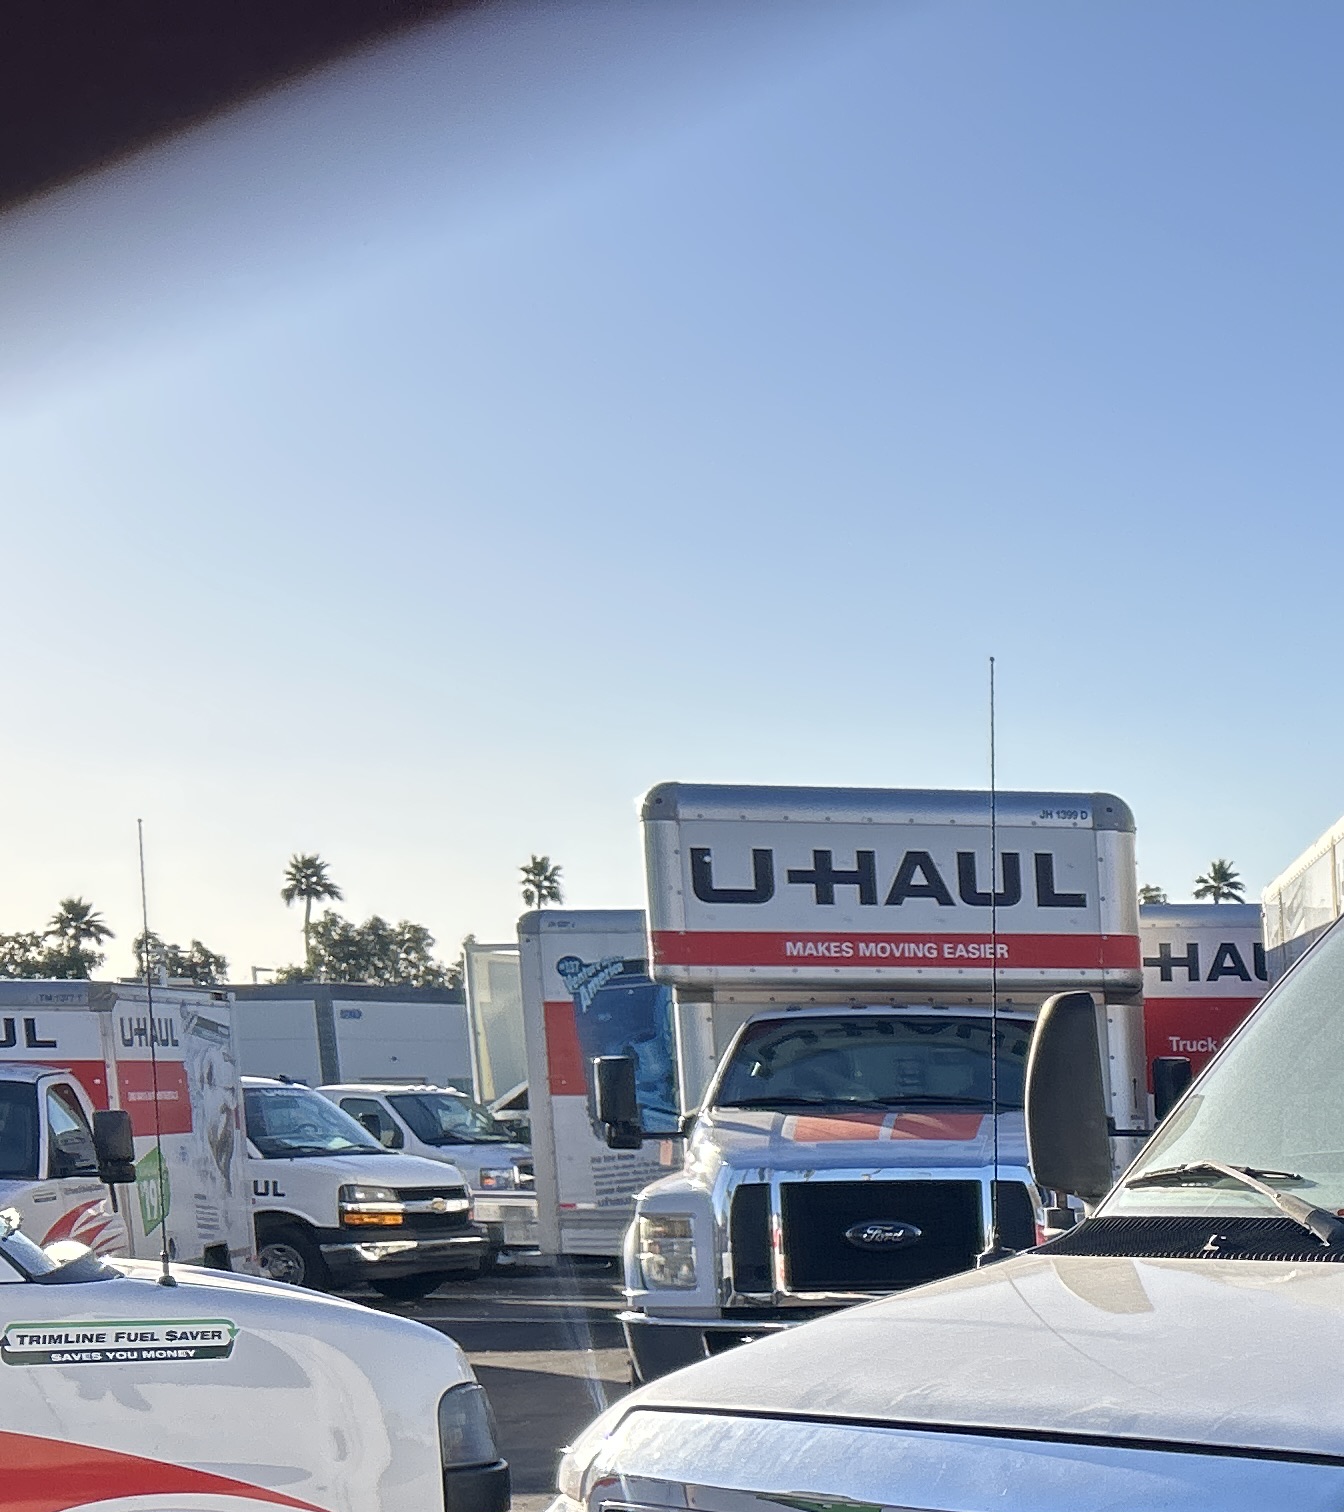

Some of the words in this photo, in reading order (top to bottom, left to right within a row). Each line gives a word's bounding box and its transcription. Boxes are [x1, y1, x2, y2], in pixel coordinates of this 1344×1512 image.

[1080, 810, 1088, 820] D
[690, 848, 1087, 908] U-HAUL
[786, 941, 854, 957] MAKES
[858, 942, 938, 958] MOVING
[943, 943, 1009, 959] EASIER
[119, 1017, 179, 1047] U-HAUL
[1169, 1037, 1217, 1052] Truck
[253, 1180, 286, 1197] UL
[16, 1332, 107, 1346] TRIMLINE
[114, 1331, 160, 1344] FUEL
[50, 1352, 102, 1362] SAVES
[106, 1351, 138, 1360] YOU
[142, 1350, 196, 1359] MONEY
